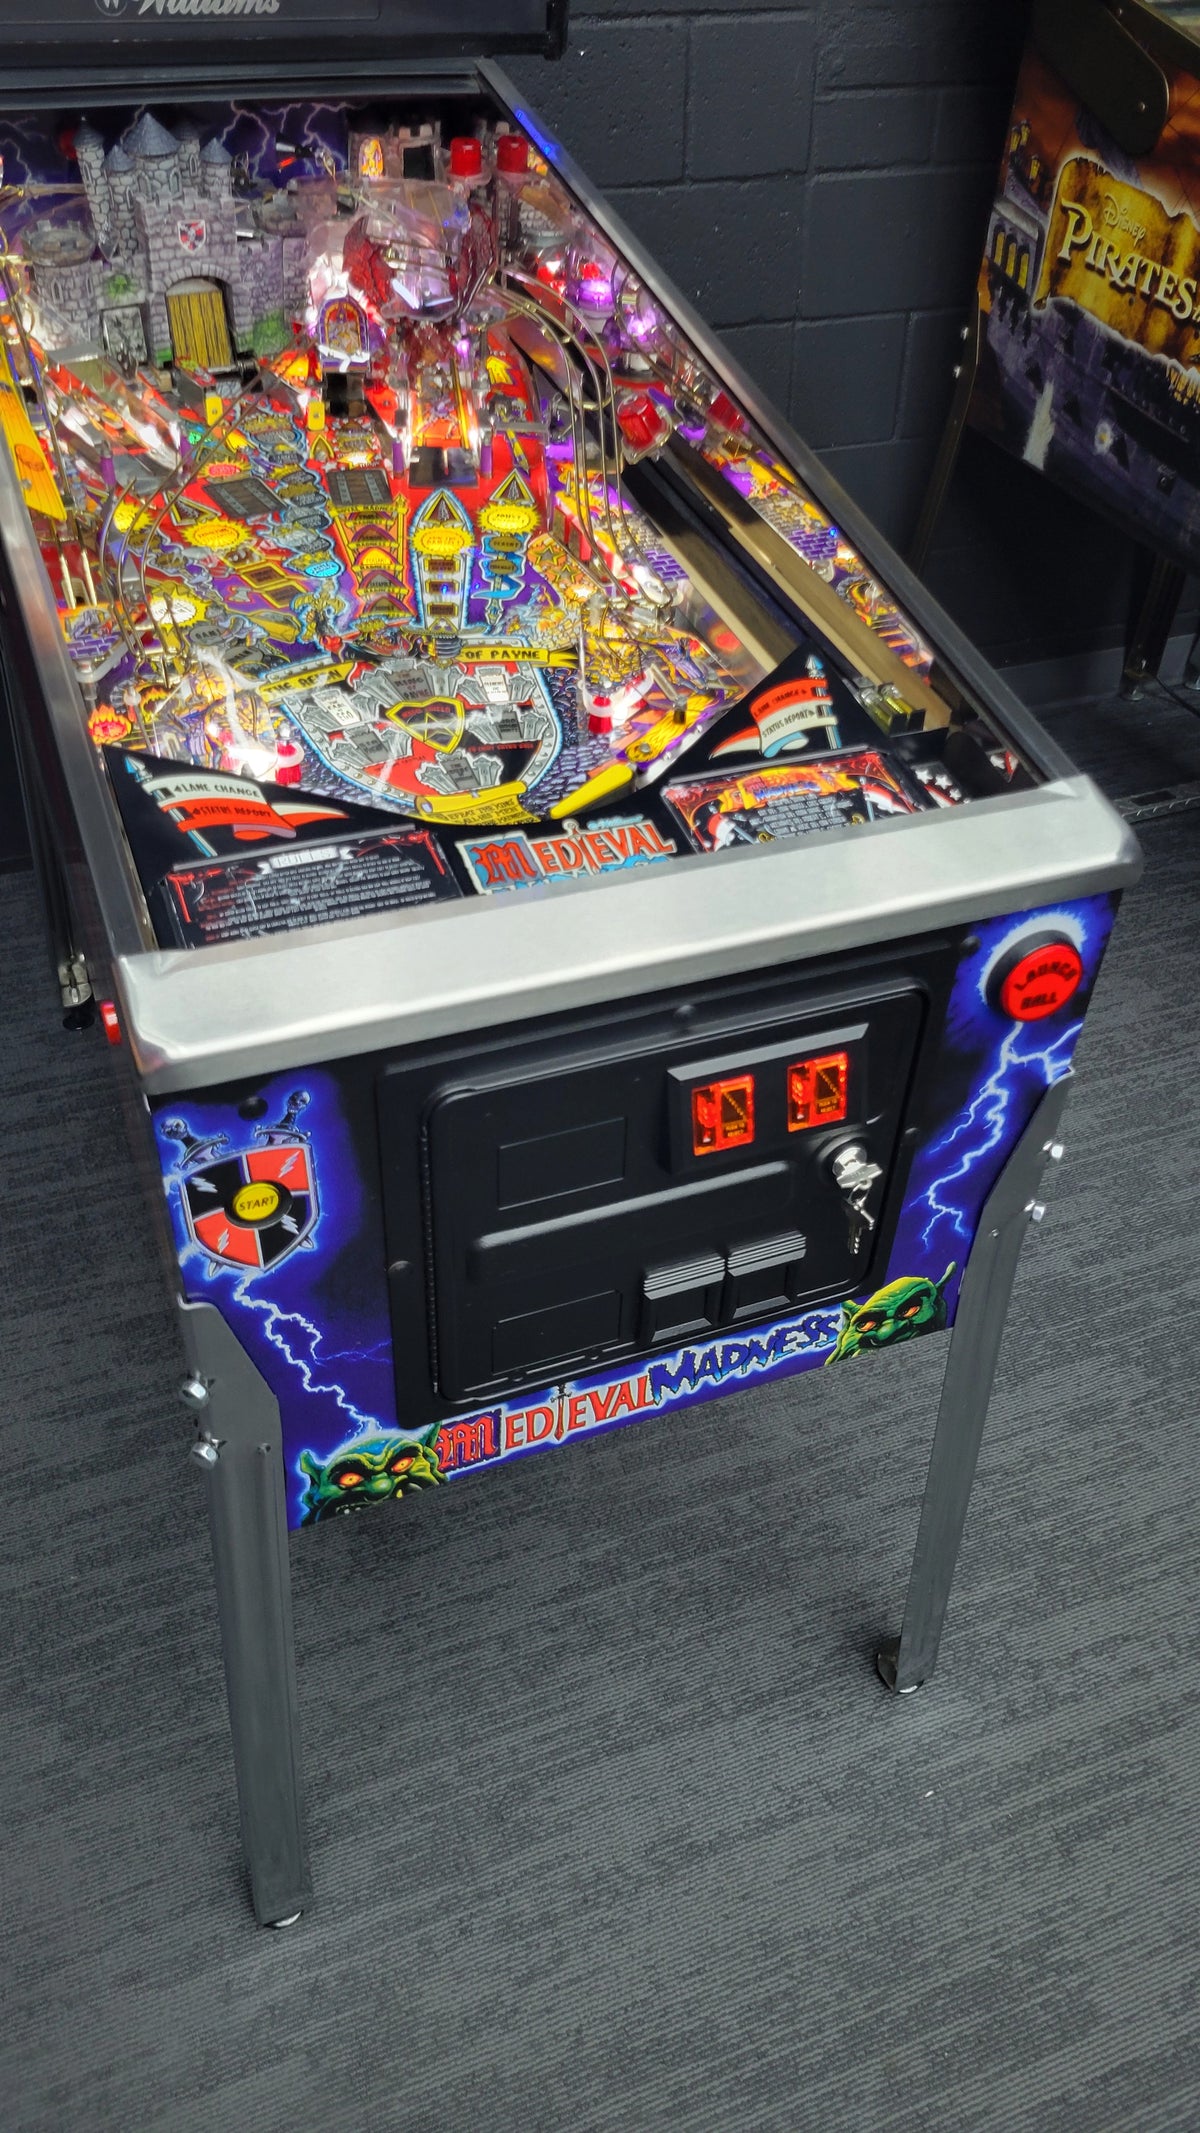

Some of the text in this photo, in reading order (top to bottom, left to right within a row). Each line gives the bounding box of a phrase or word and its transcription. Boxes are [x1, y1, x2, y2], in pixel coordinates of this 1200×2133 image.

[1104, 193, 1146, 246] Disney
[1058, 198, 1197, 319] PIRATES
[264, 650, 540, 693] THE REN OF PAYNE
[762, 708, 809, 738] STATUS REPORT
[181, 783, 260, 798] LANE CHANGE
[199, 805, 272, 817] STATUS REPORT
[470, 820, 675, 886] MEDIEVAL
[1013, 961, 1078, 992] LAUNCH
[1020, 991, 1058, 1011] BALL
[239, 1195, 276, 1211] START
[435, 1314, 841, 1473] MEDIEVAL MADNESS
